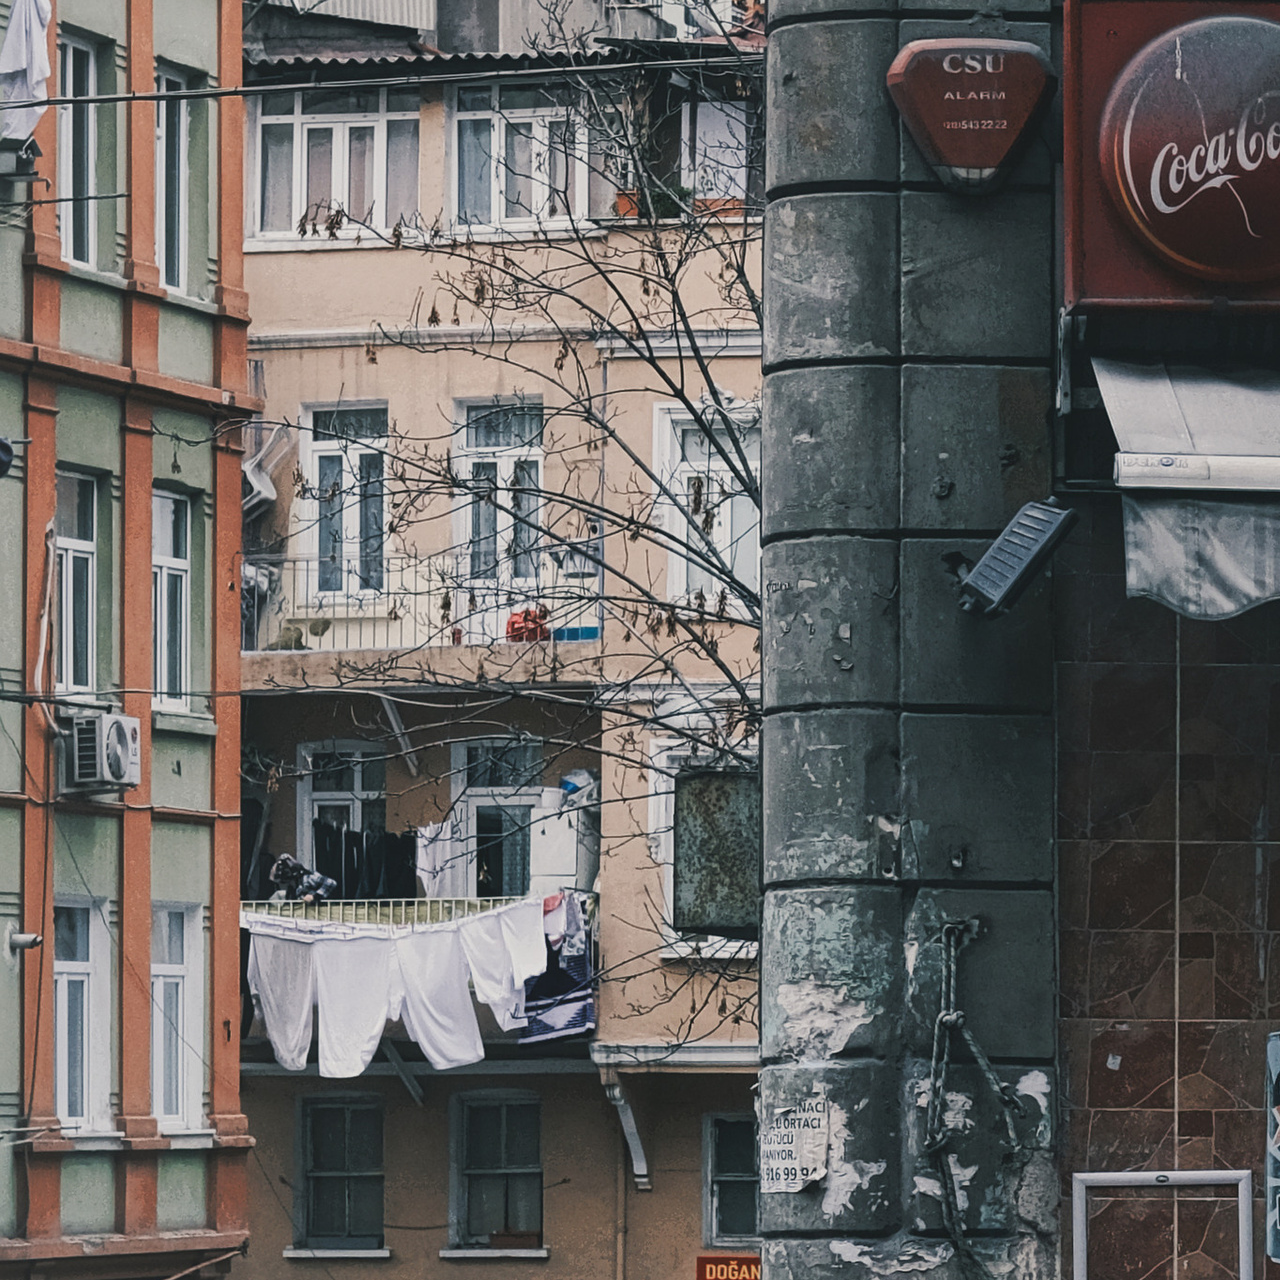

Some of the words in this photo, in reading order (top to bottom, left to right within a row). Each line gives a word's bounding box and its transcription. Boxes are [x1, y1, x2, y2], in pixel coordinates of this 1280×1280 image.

[943, 54, 1005, 74] CSU
[944, 91, 1006, 100] ALARM
[783, 1118, 821, 1130] ORTACI
